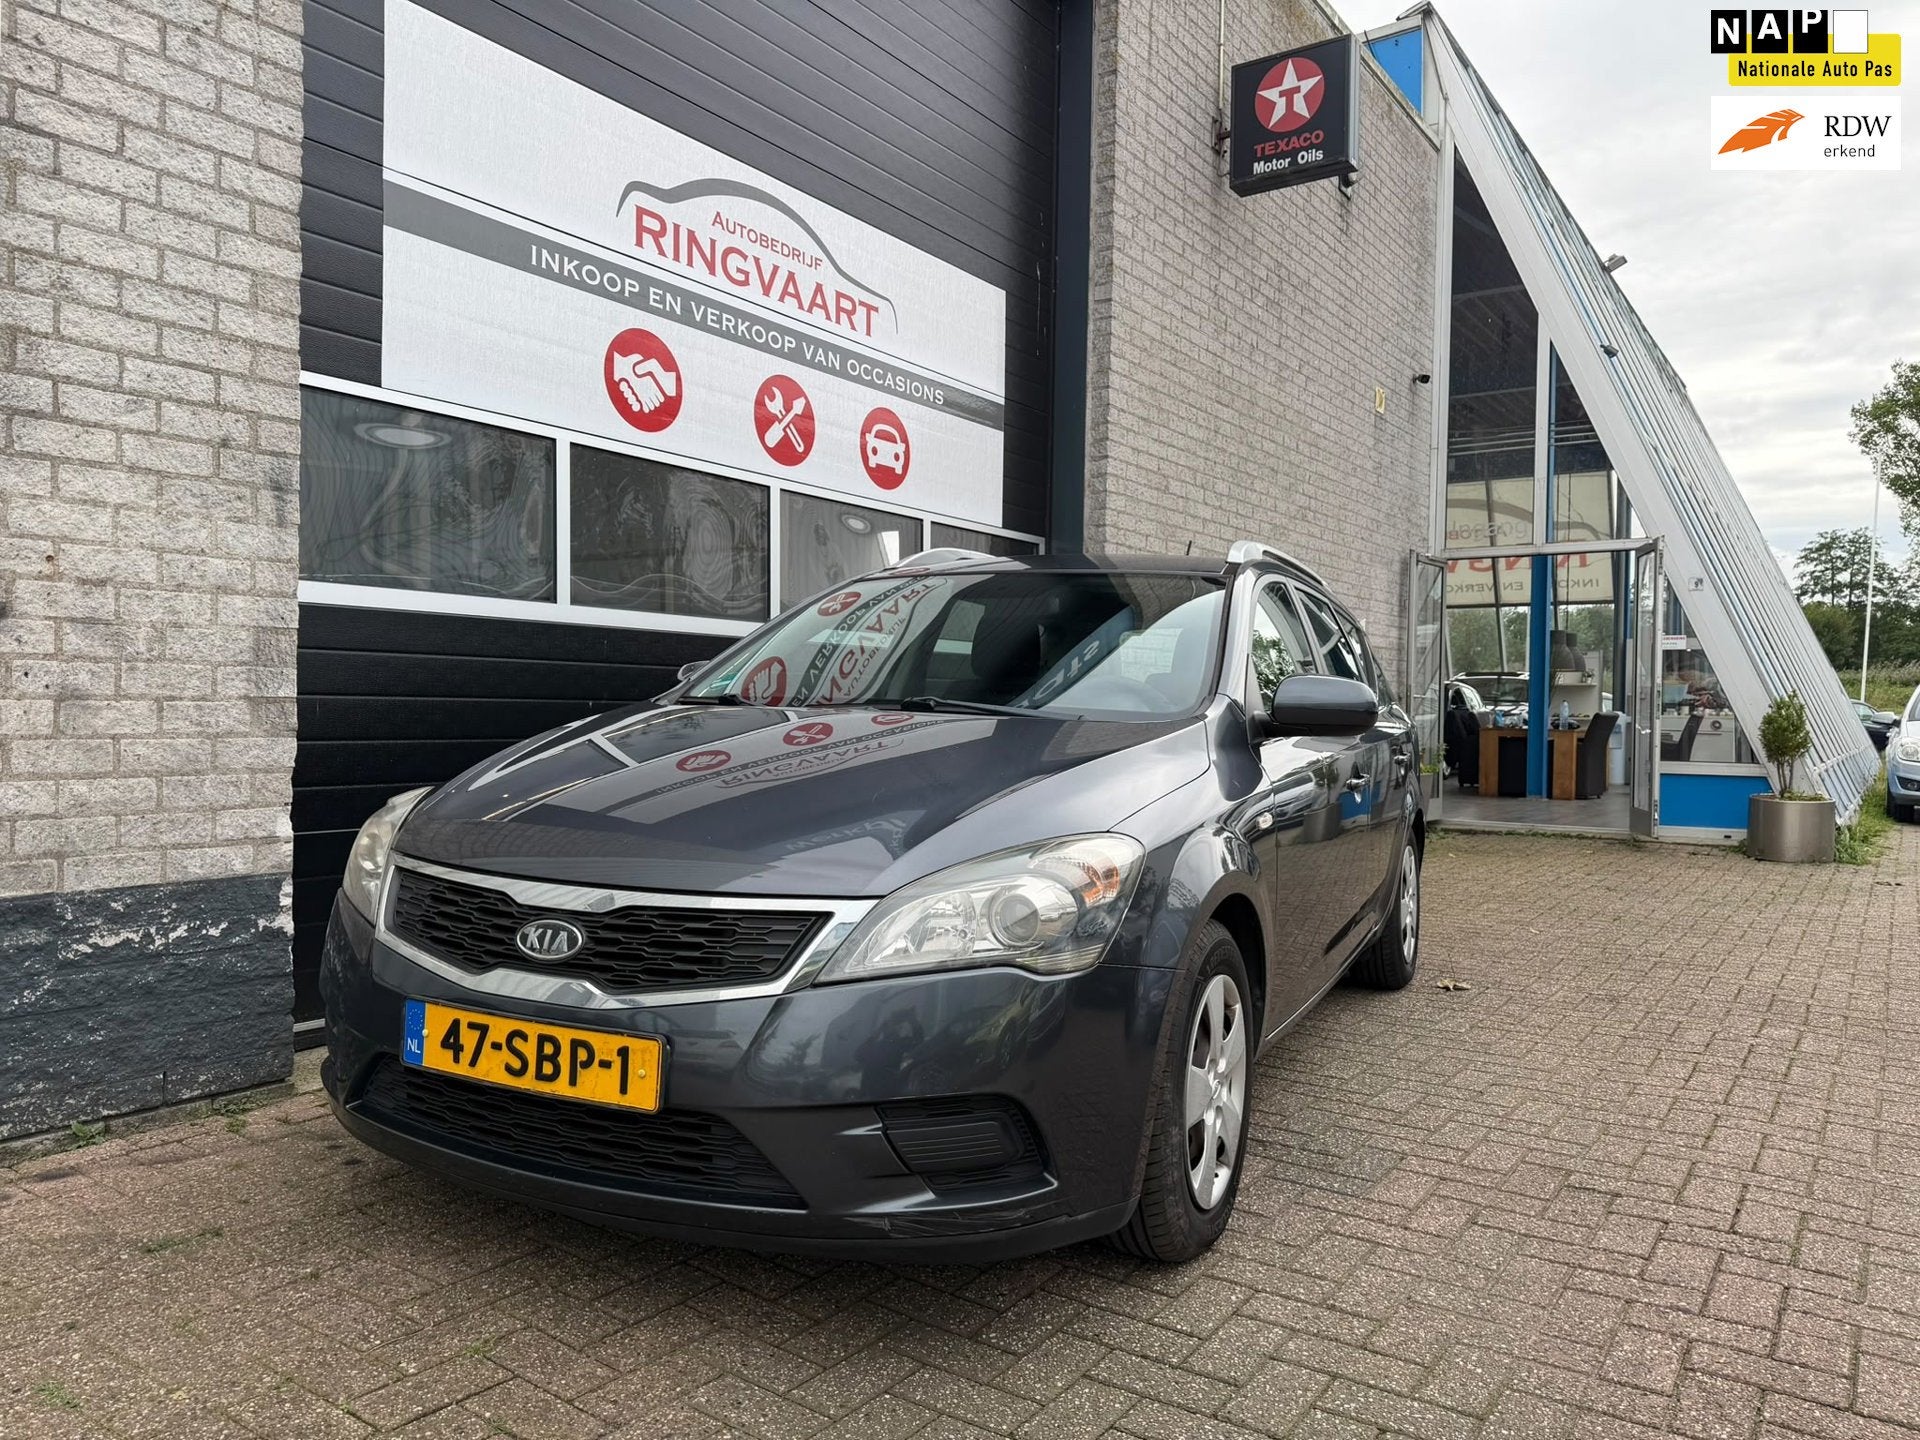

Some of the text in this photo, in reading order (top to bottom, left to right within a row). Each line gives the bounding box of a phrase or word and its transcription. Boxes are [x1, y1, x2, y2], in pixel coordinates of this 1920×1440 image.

[1253, 149, 1324, 175] Motor Oils
[1254, 130, 1325, 158] TEXACO
[711, 211, 823, 271] AUTOBEDRIJF
[634, 204, 879, 337] RINGVAART
[531, 245, 945, 405] INKOOP EN VERKOOP VAN OCCASIONS
[524, 925, 569, 952] KIA
[407, 1037, 421, 1054] NL
[440, 1017, 630, 1095] 47-SBP-1
